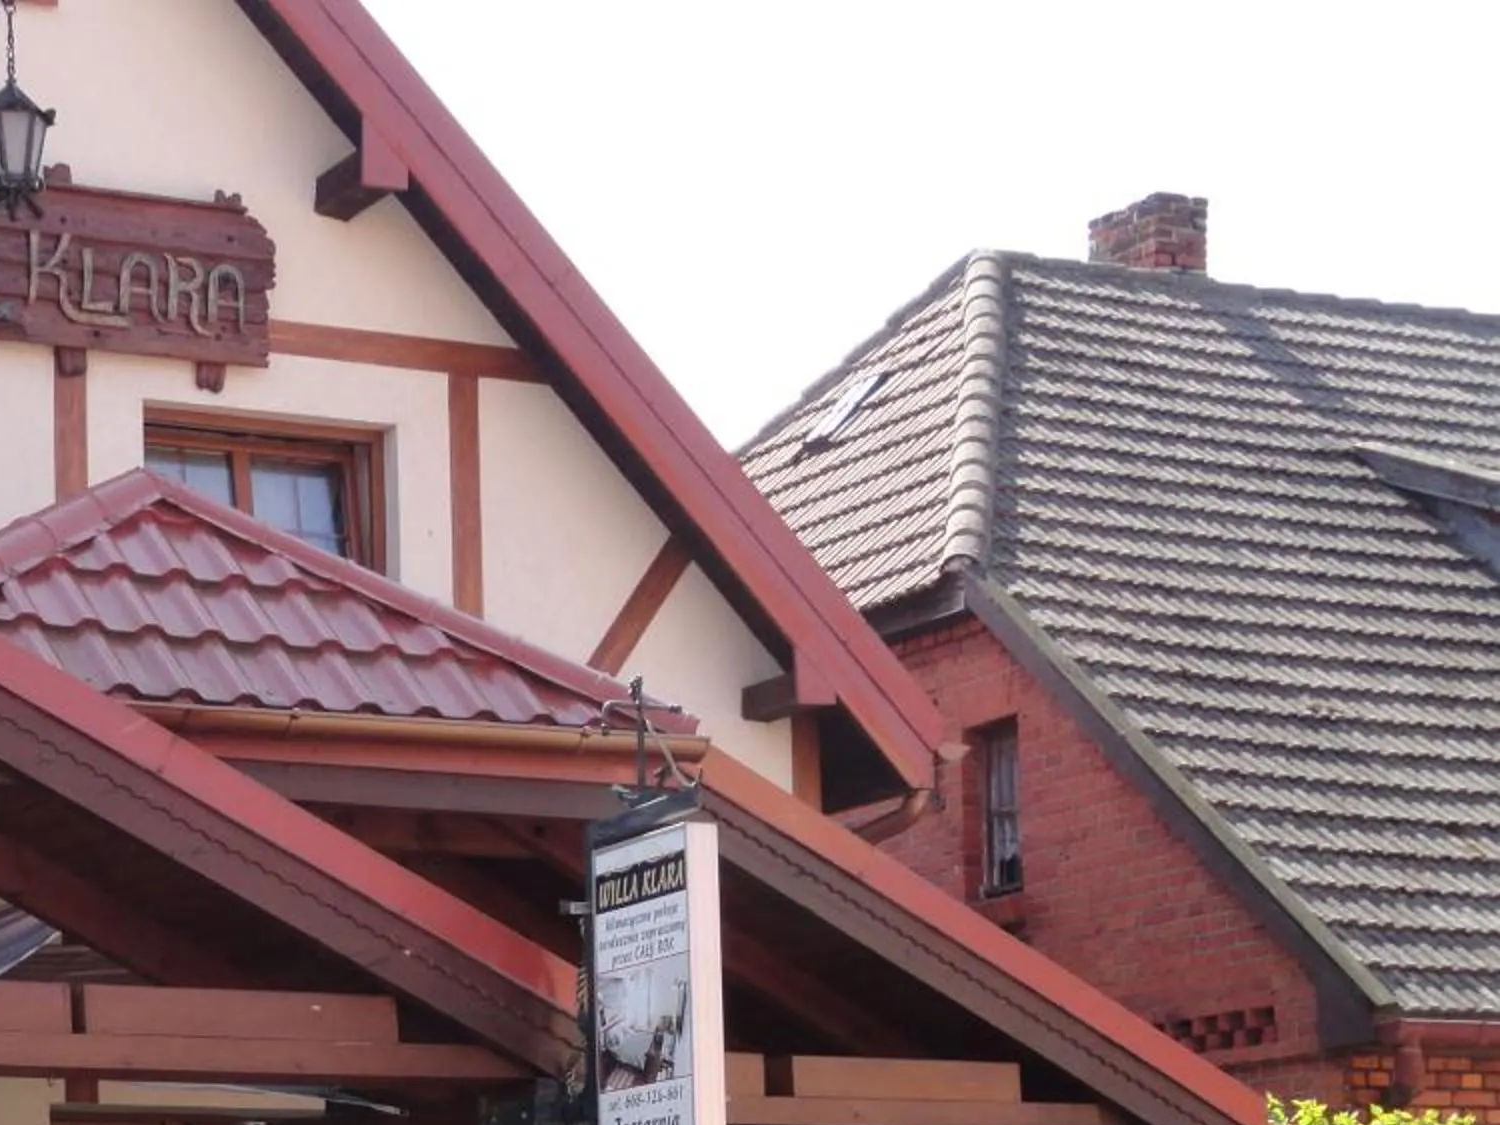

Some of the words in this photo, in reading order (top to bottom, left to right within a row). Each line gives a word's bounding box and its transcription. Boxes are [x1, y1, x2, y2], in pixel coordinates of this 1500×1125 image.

[26, 229, 246, 338] KLARA
[599, 872, 638, 909] WILLA
[641, 858, 684, 897] KLARA
